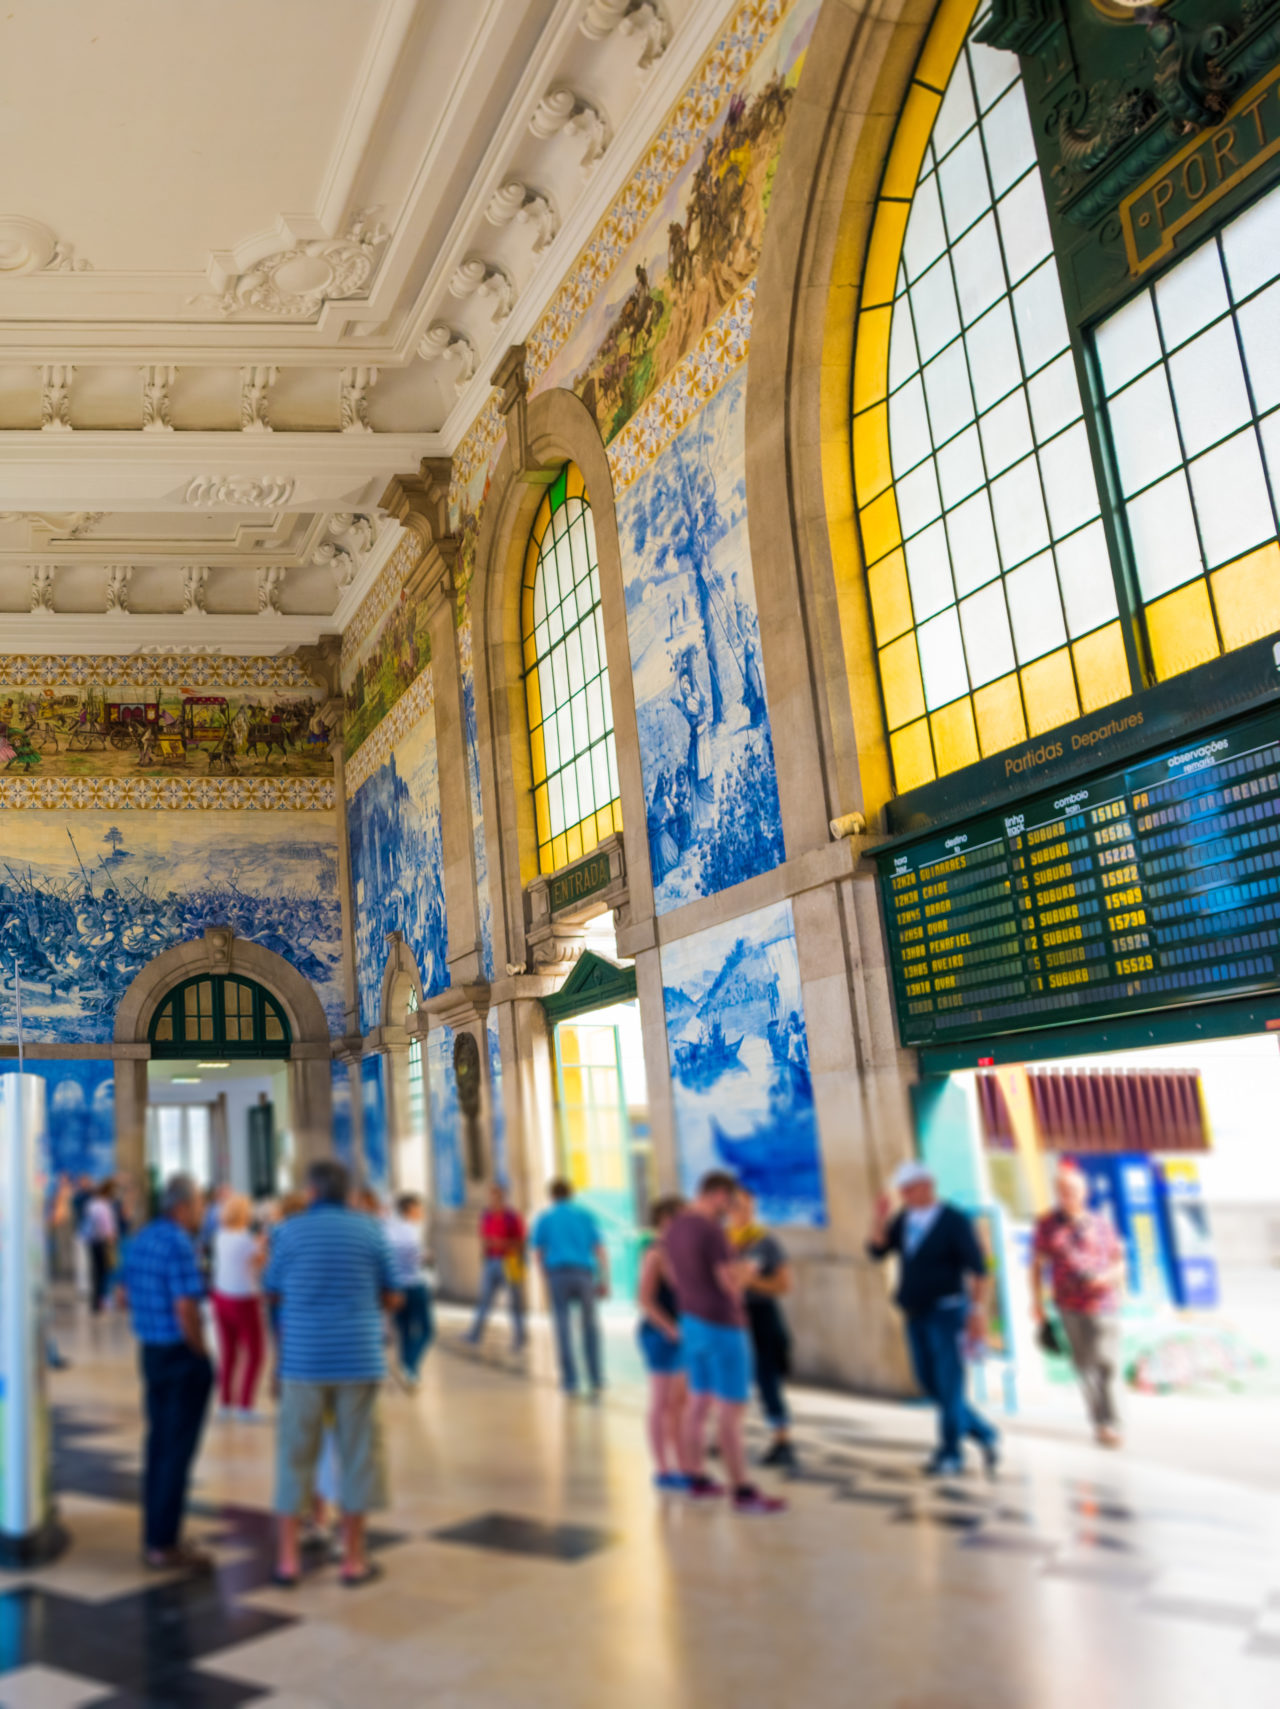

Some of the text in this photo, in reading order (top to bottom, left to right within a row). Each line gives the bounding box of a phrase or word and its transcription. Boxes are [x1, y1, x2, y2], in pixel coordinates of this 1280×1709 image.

[1152, 84, 1280, 230] PORT
[1005, 711, 1144, 777] Partidas Departures
[1167, 739, 1228, 767] observações
[1054, 790, 1089, 809] comboio
[1004, 814, 1024, 828] linha
[1027, 821, 1065, 846] SUBURB
[1091, 800, 1127, 824] 15161
[1030, 842, 1068, 866] SUBURB
[553, 859, 609, 905] ENTRADA
[1022, 876, 1028, 889] 5
[1033, 863, 1072, 886] SUBURB
[1036, 883, 1075, 906] SUBURB
[1101, 865, 1138, 888] 15922
[929, 933, 971, 954] PENAFIEL
[1028, 916, 1035, 929] 3
[1040, 904, 1079, 926] SUBURB
[932, 954, 964, 973] AVEIRO
[1031, 936, 1038, 949] 2
[1043, 925, 1082, 947] SUBURB
[1034, 956, 1040, 970] 5
[1046, 947, 1085, 968] SUBURB
[1112, 933, 1149, 953] 15924
[1037, 977, 1043, 990] 1
[1049, 968, 1088, 988] SUBURB
[1115, 954, 1153, 975] 15529
